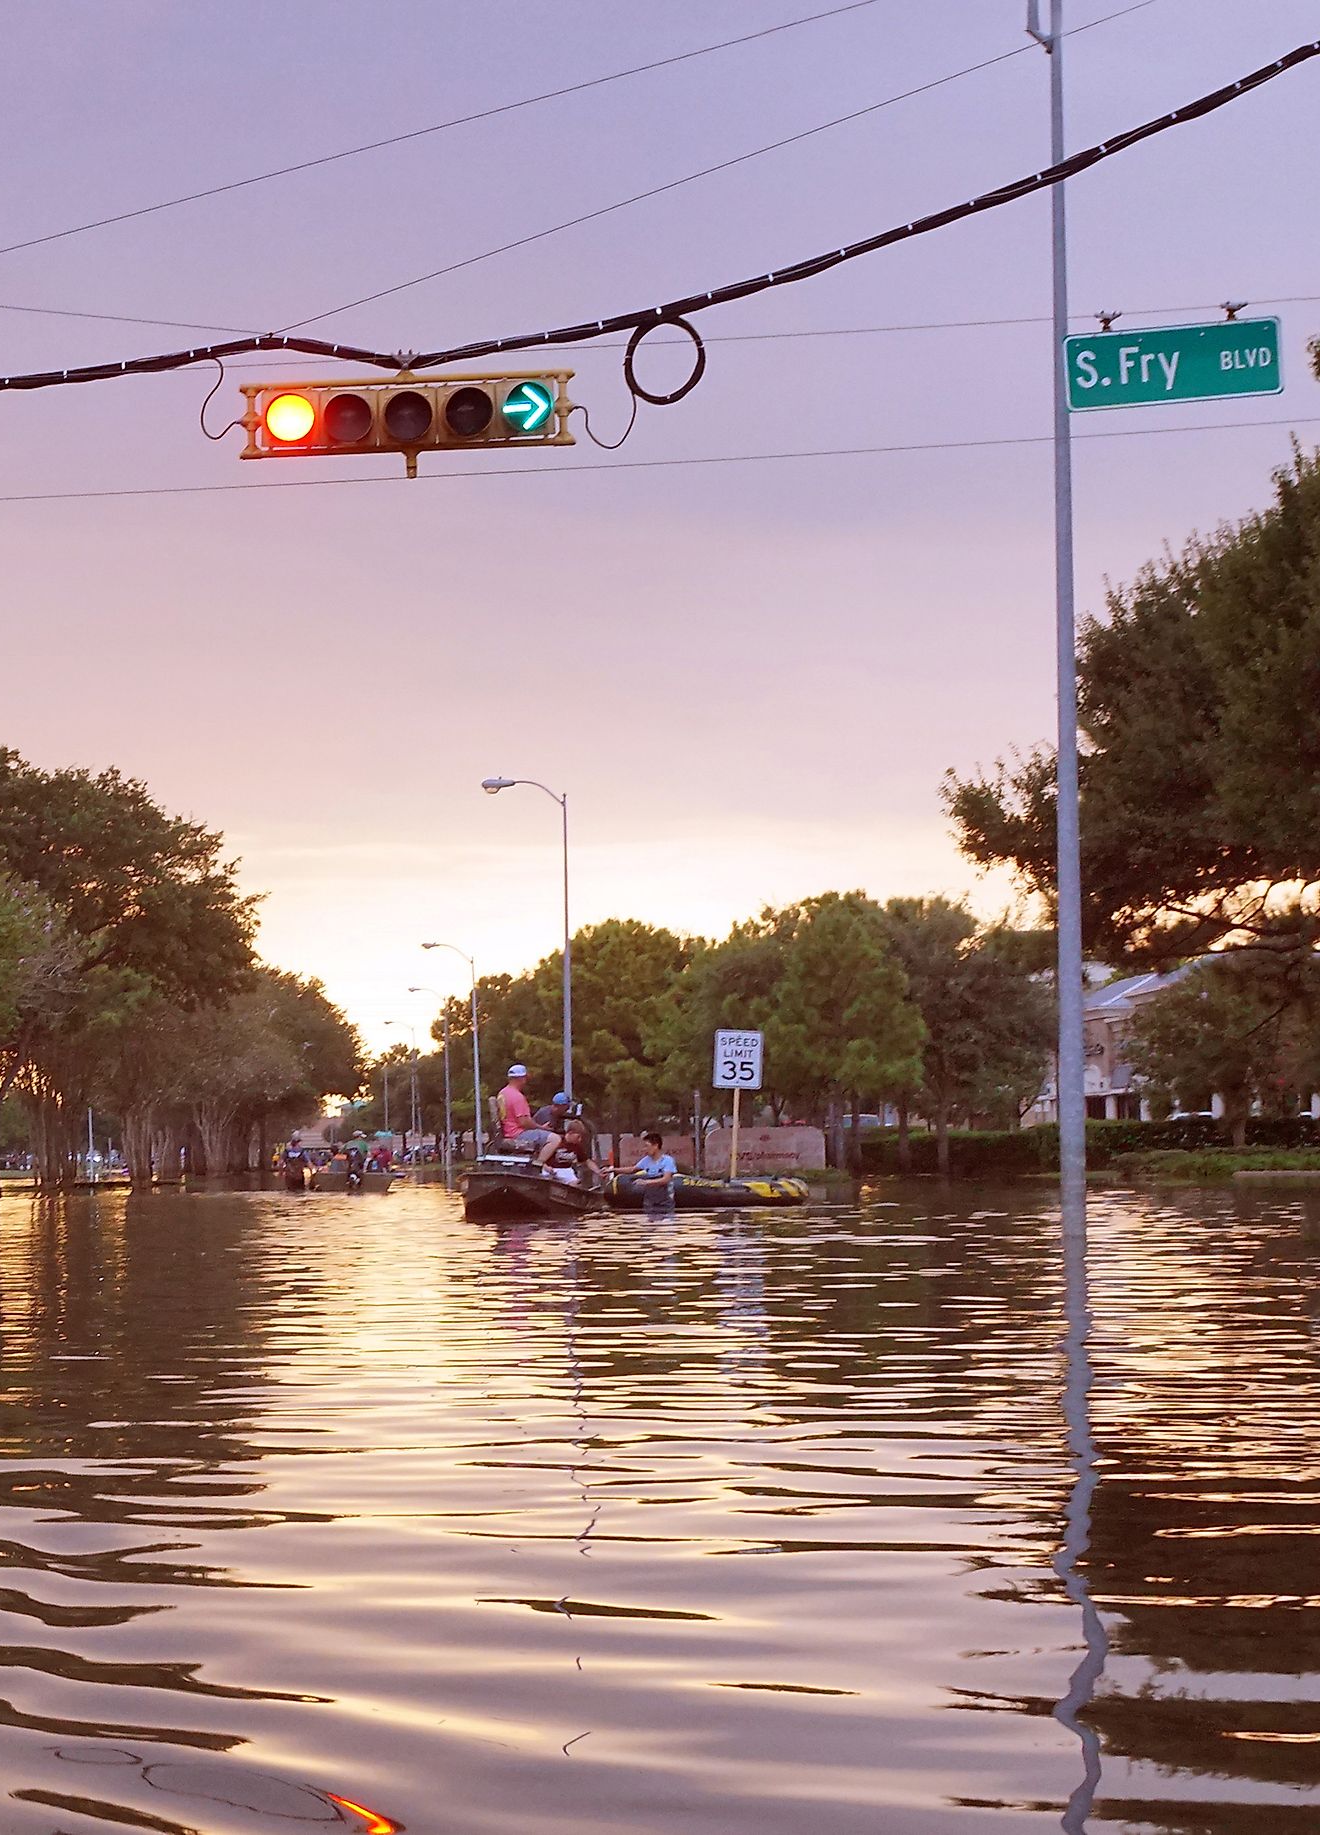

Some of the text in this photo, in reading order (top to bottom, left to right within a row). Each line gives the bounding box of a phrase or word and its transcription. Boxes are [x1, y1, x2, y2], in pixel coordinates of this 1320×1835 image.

[1118, 346, 1180, 391] Fry
[1220, 346, 1272, 371] BLVD
[720, 1036, 759, 1048] SPEED
[723, 1049, 754, 1059] LIMIT
[721, 1060, 755, 1081] 35
